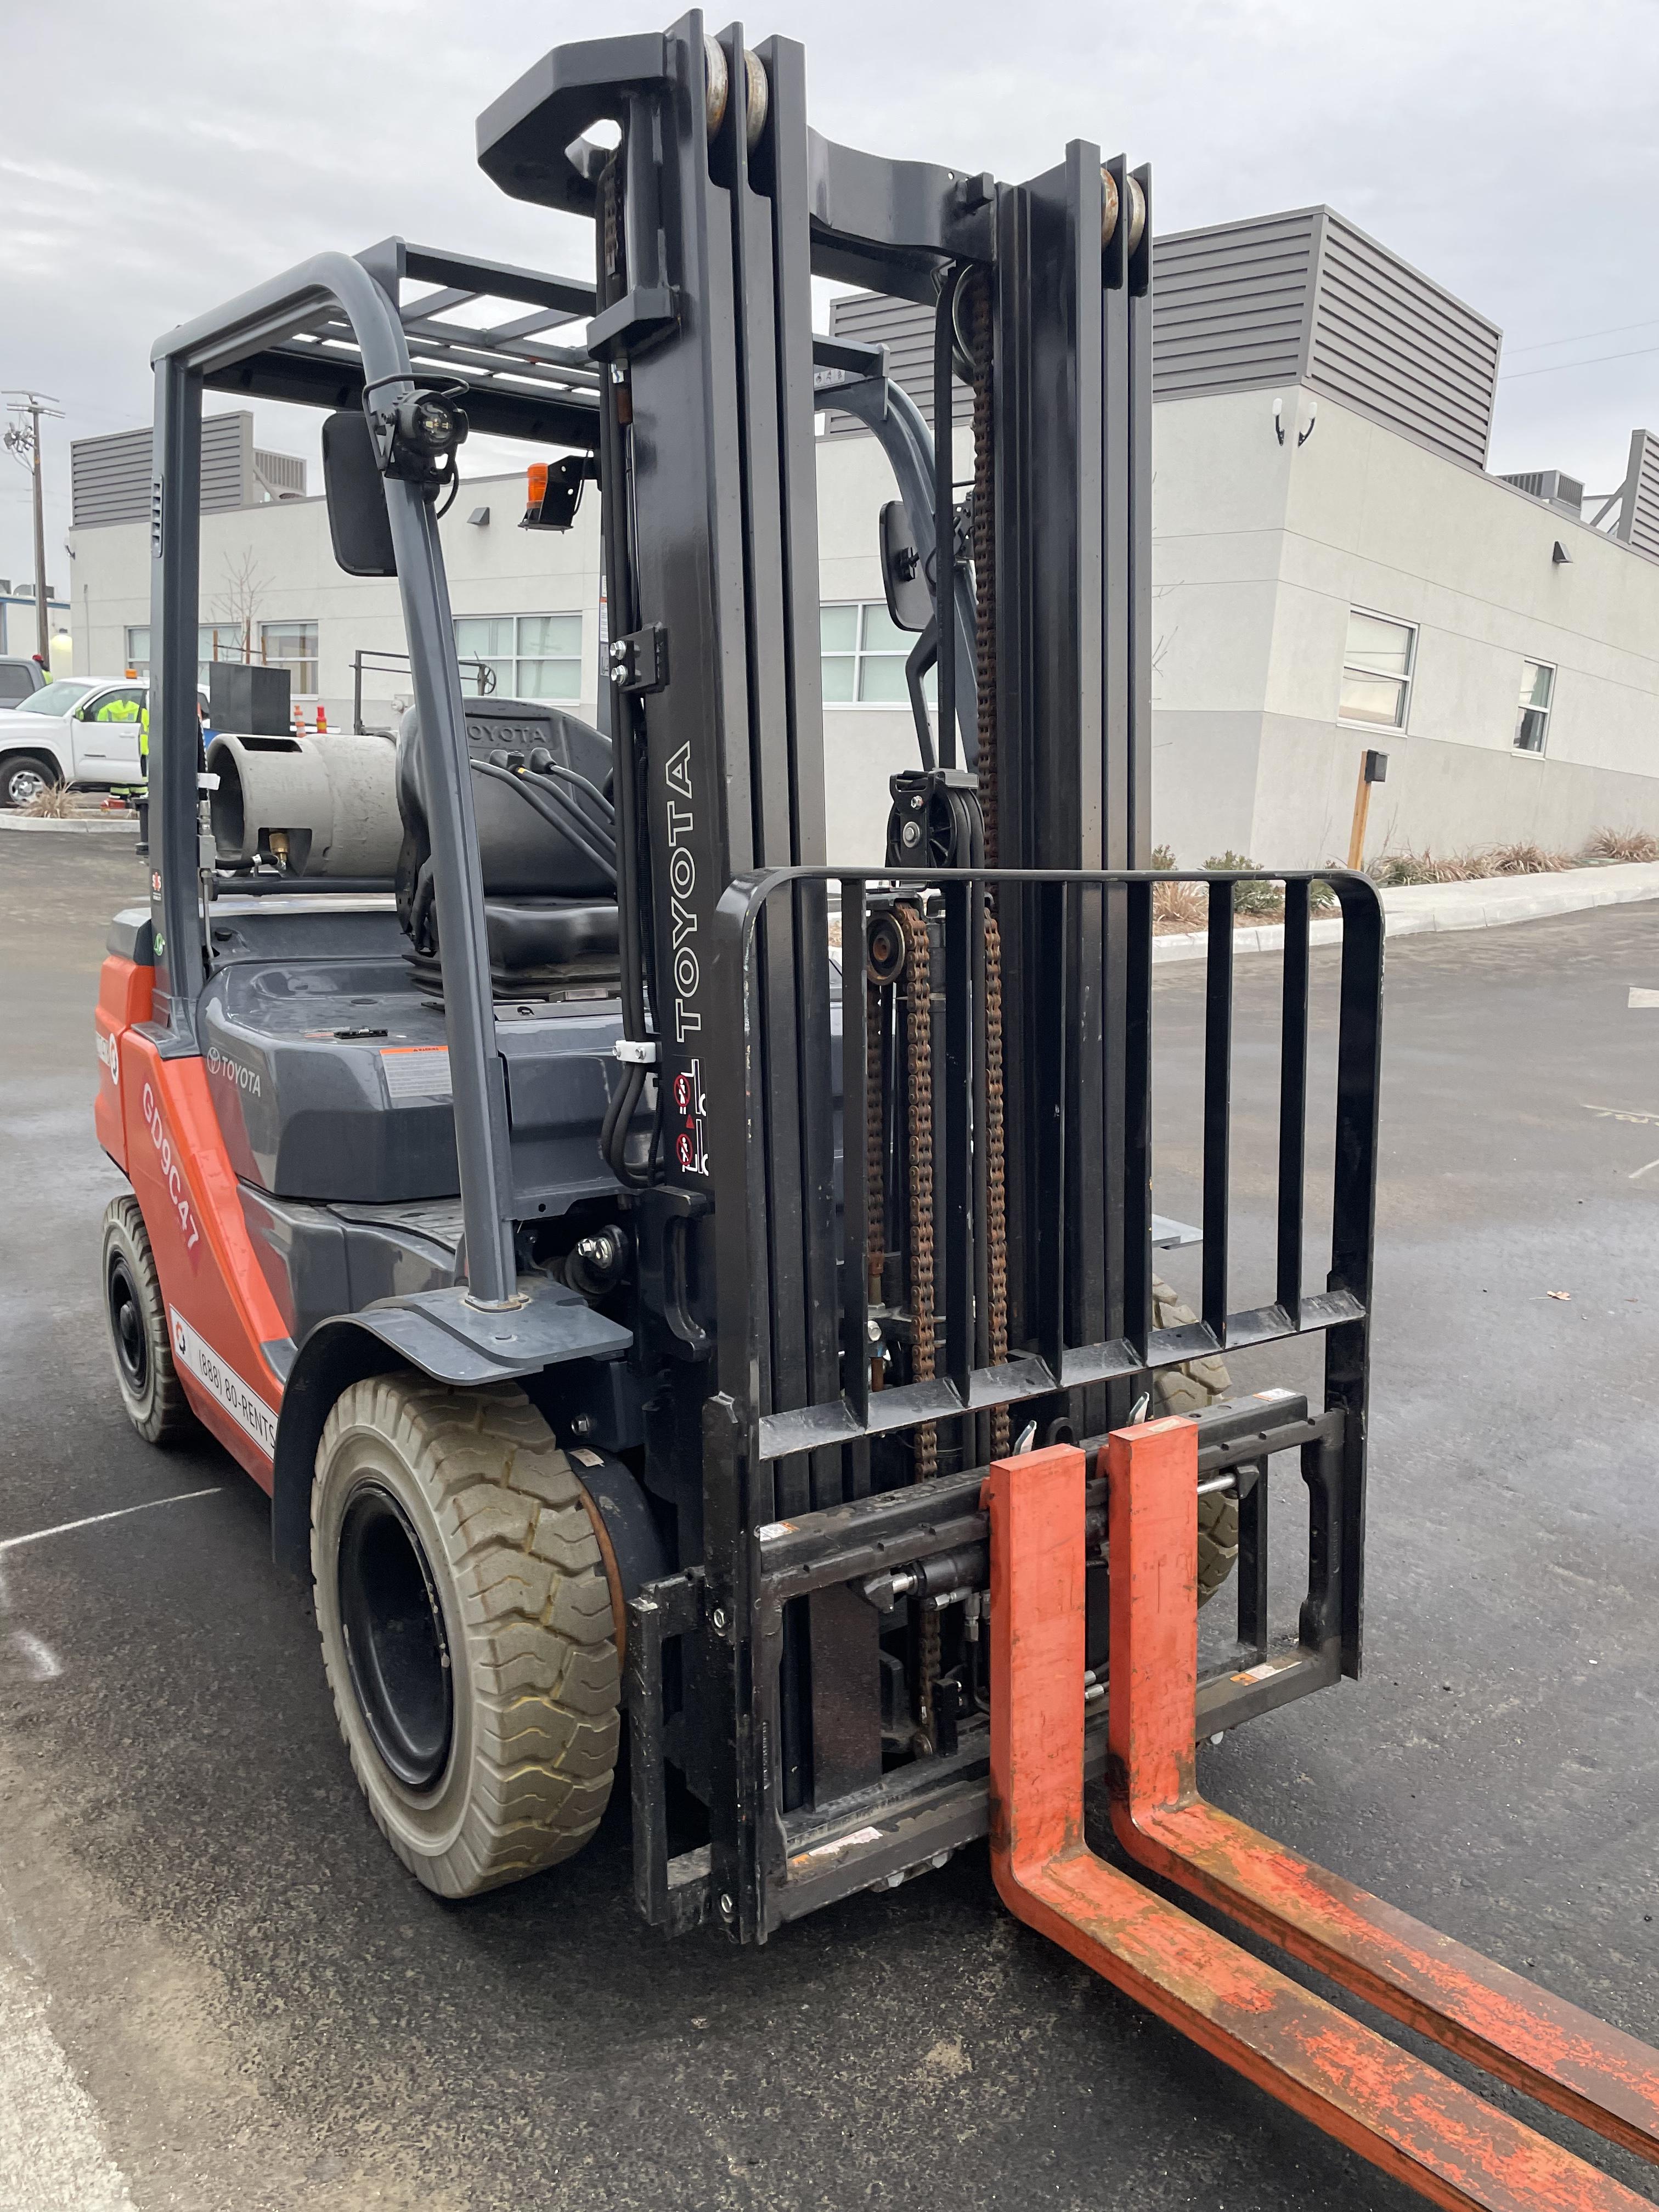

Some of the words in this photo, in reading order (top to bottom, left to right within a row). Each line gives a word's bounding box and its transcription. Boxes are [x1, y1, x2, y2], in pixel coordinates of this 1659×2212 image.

[466, 726, 548, 743] OYOTA
[665, 740, 702, 1042] TOYOTA
[222, 1056, 261, 1098] TOYOTA
[143, 1082, 200, 1250] GD9C47
[199, 1349, 222, 1395] (888)
[225, 1379, 275, 1449] 80-RENTS
